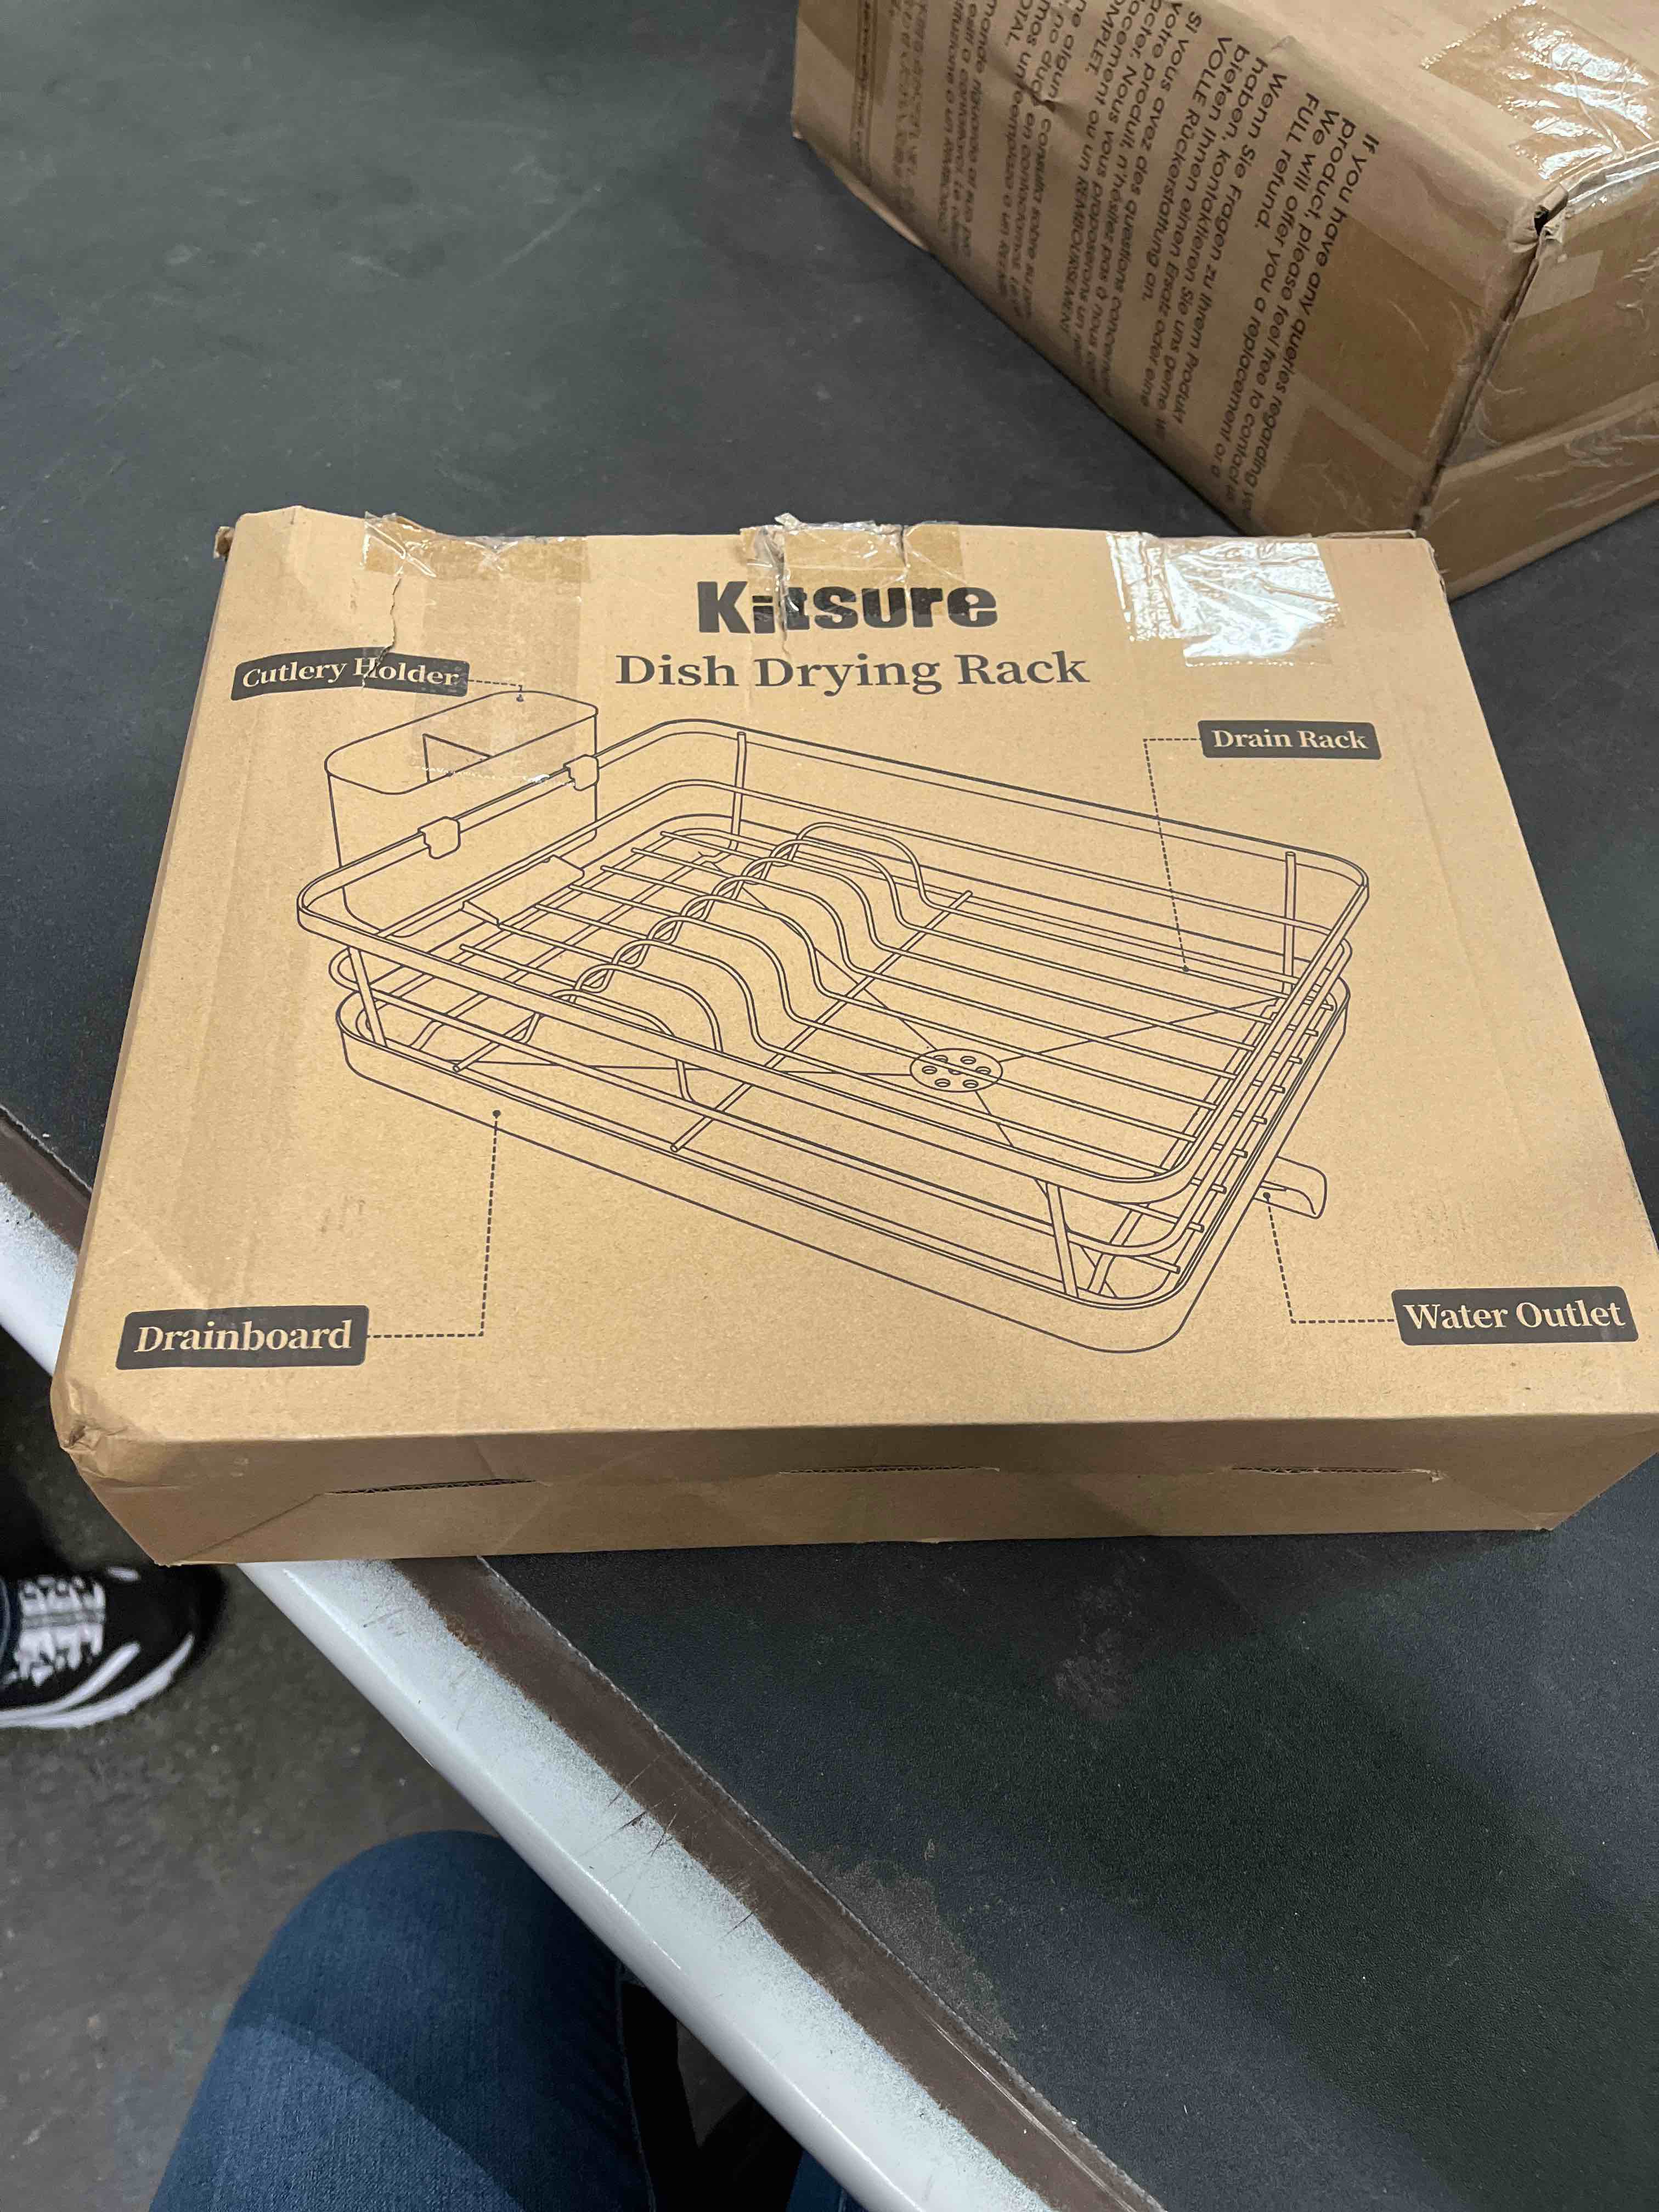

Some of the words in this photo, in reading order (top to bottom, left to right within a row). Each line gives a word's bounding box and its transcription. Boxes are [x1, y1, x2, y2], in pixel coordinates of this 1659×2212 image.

[1152, 0, 1182, 61] votre
[1185, 10, 1202, 36] Si
[1095, 0, 1143, 106] acement
[1160, 34, 1188, 94] vous
[1192, 31, 1232, 107] VOLLE
[1108, 63, 1137, 125] Nous
[1119, 62, 1155, 154] produit,
[1209, 43, 1249, 124] bieten
[1247, 68, 1287, 143] Wenn
[1086, 106, 1100, 140] ou
[1141, 94, 1165, 152] avez
[1286, 92, 1319, 148] FULL
[1311, 104, 1339, 150] We
[1361, 132, 1379, 155] If
[1080, 140, 1092, 173] un
[1097, 126, 1114, 180] vous
[1131, 153, 1150, 198] des
[1186, 126, 1216, 195] Ihnen
[1233, 143, 1255, 182] Sie
[1294, 148, 1316, 192] will
[1304, 117, 1356, 225] product,
[1338, 152, 1367, 205] you
[1146, 106, 1201, 269] Rückerstattung
[1254, 148, 1293, 235] refund.
[1170, 196, 1193, 261] einen
[1184, 146, 1231, 286] kontaktieren
[1208, 182, 1242, 263] Fragen
[1274, 193, 1299, 250] offer
[1314, 205, 1347, 270] have
[1099, 242, 1111, 284] pas
[1113, 196, 1137, 294] questions
[1261, 247, 1281, 294] you
[1280, 222, 1313, 305] please
[1159, 260, 1179, 318] Ersatz
[1177, 285, 1194, 318] Sie
[1203, 262, 1216, 291] zu
[1254, 295, 1267, 314] a
[1299, 268, 1322, 316] any
[1149, 317, 1166, 366] oder
[1170, 318, 1185, 355] uns
[1189, 291, 1212, 352] Ihrem
[1268, 304, 1289, 347] feel
[1157, 351, 1176, 414] gerne
[1220, 313, 1260, 443] replacement
[1256, 347, 1276, 387] free
[1276, 314, 1306, 397] queries
[1139, 366, 1155, 409] eine
[1173, 350, 1199, 425] Produkt
[1250, 388, 1265, 413] to
[1214, 441, 1226, 466] or
[1228, 410, 1255, 486] contact
[1244, 394, 1283, 491] regarding
[242, 661, 347, 689] Cutlery
[352, 657, 460, 686] Holder
[615, 654, 736, 687] Dish
[754, 652, 941, 697] Drying
[953, 651, 1090, 685] Rack
[1211, 729, 1293, 748] Drain
[1296, 730, 1369, 749] Rack
[133, 1319, 352, 1353] Drainboard
[1402, 1304, 1508, 1330] Water
[1515, 1299, 1626, 1328] Outlet
